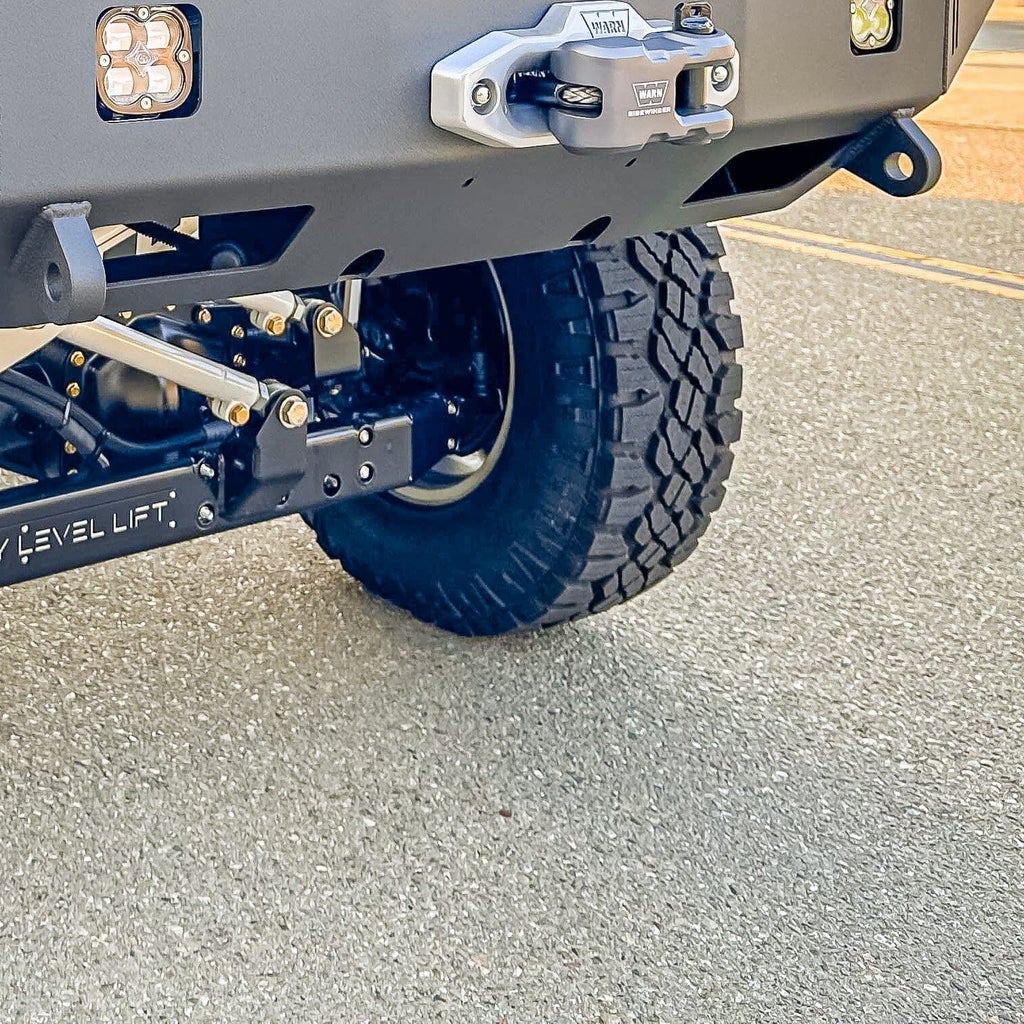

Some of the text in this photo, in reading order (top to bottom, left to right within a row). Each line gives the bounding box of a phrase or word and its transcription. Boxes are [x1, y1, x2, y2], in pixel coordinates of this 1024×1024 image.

[591, 20, 626, 34] WARN
[639, 88, 663, 99] WARN
[18, 518, 105, 557] LEVEL
[113, 501, 169, 533] LIFT
